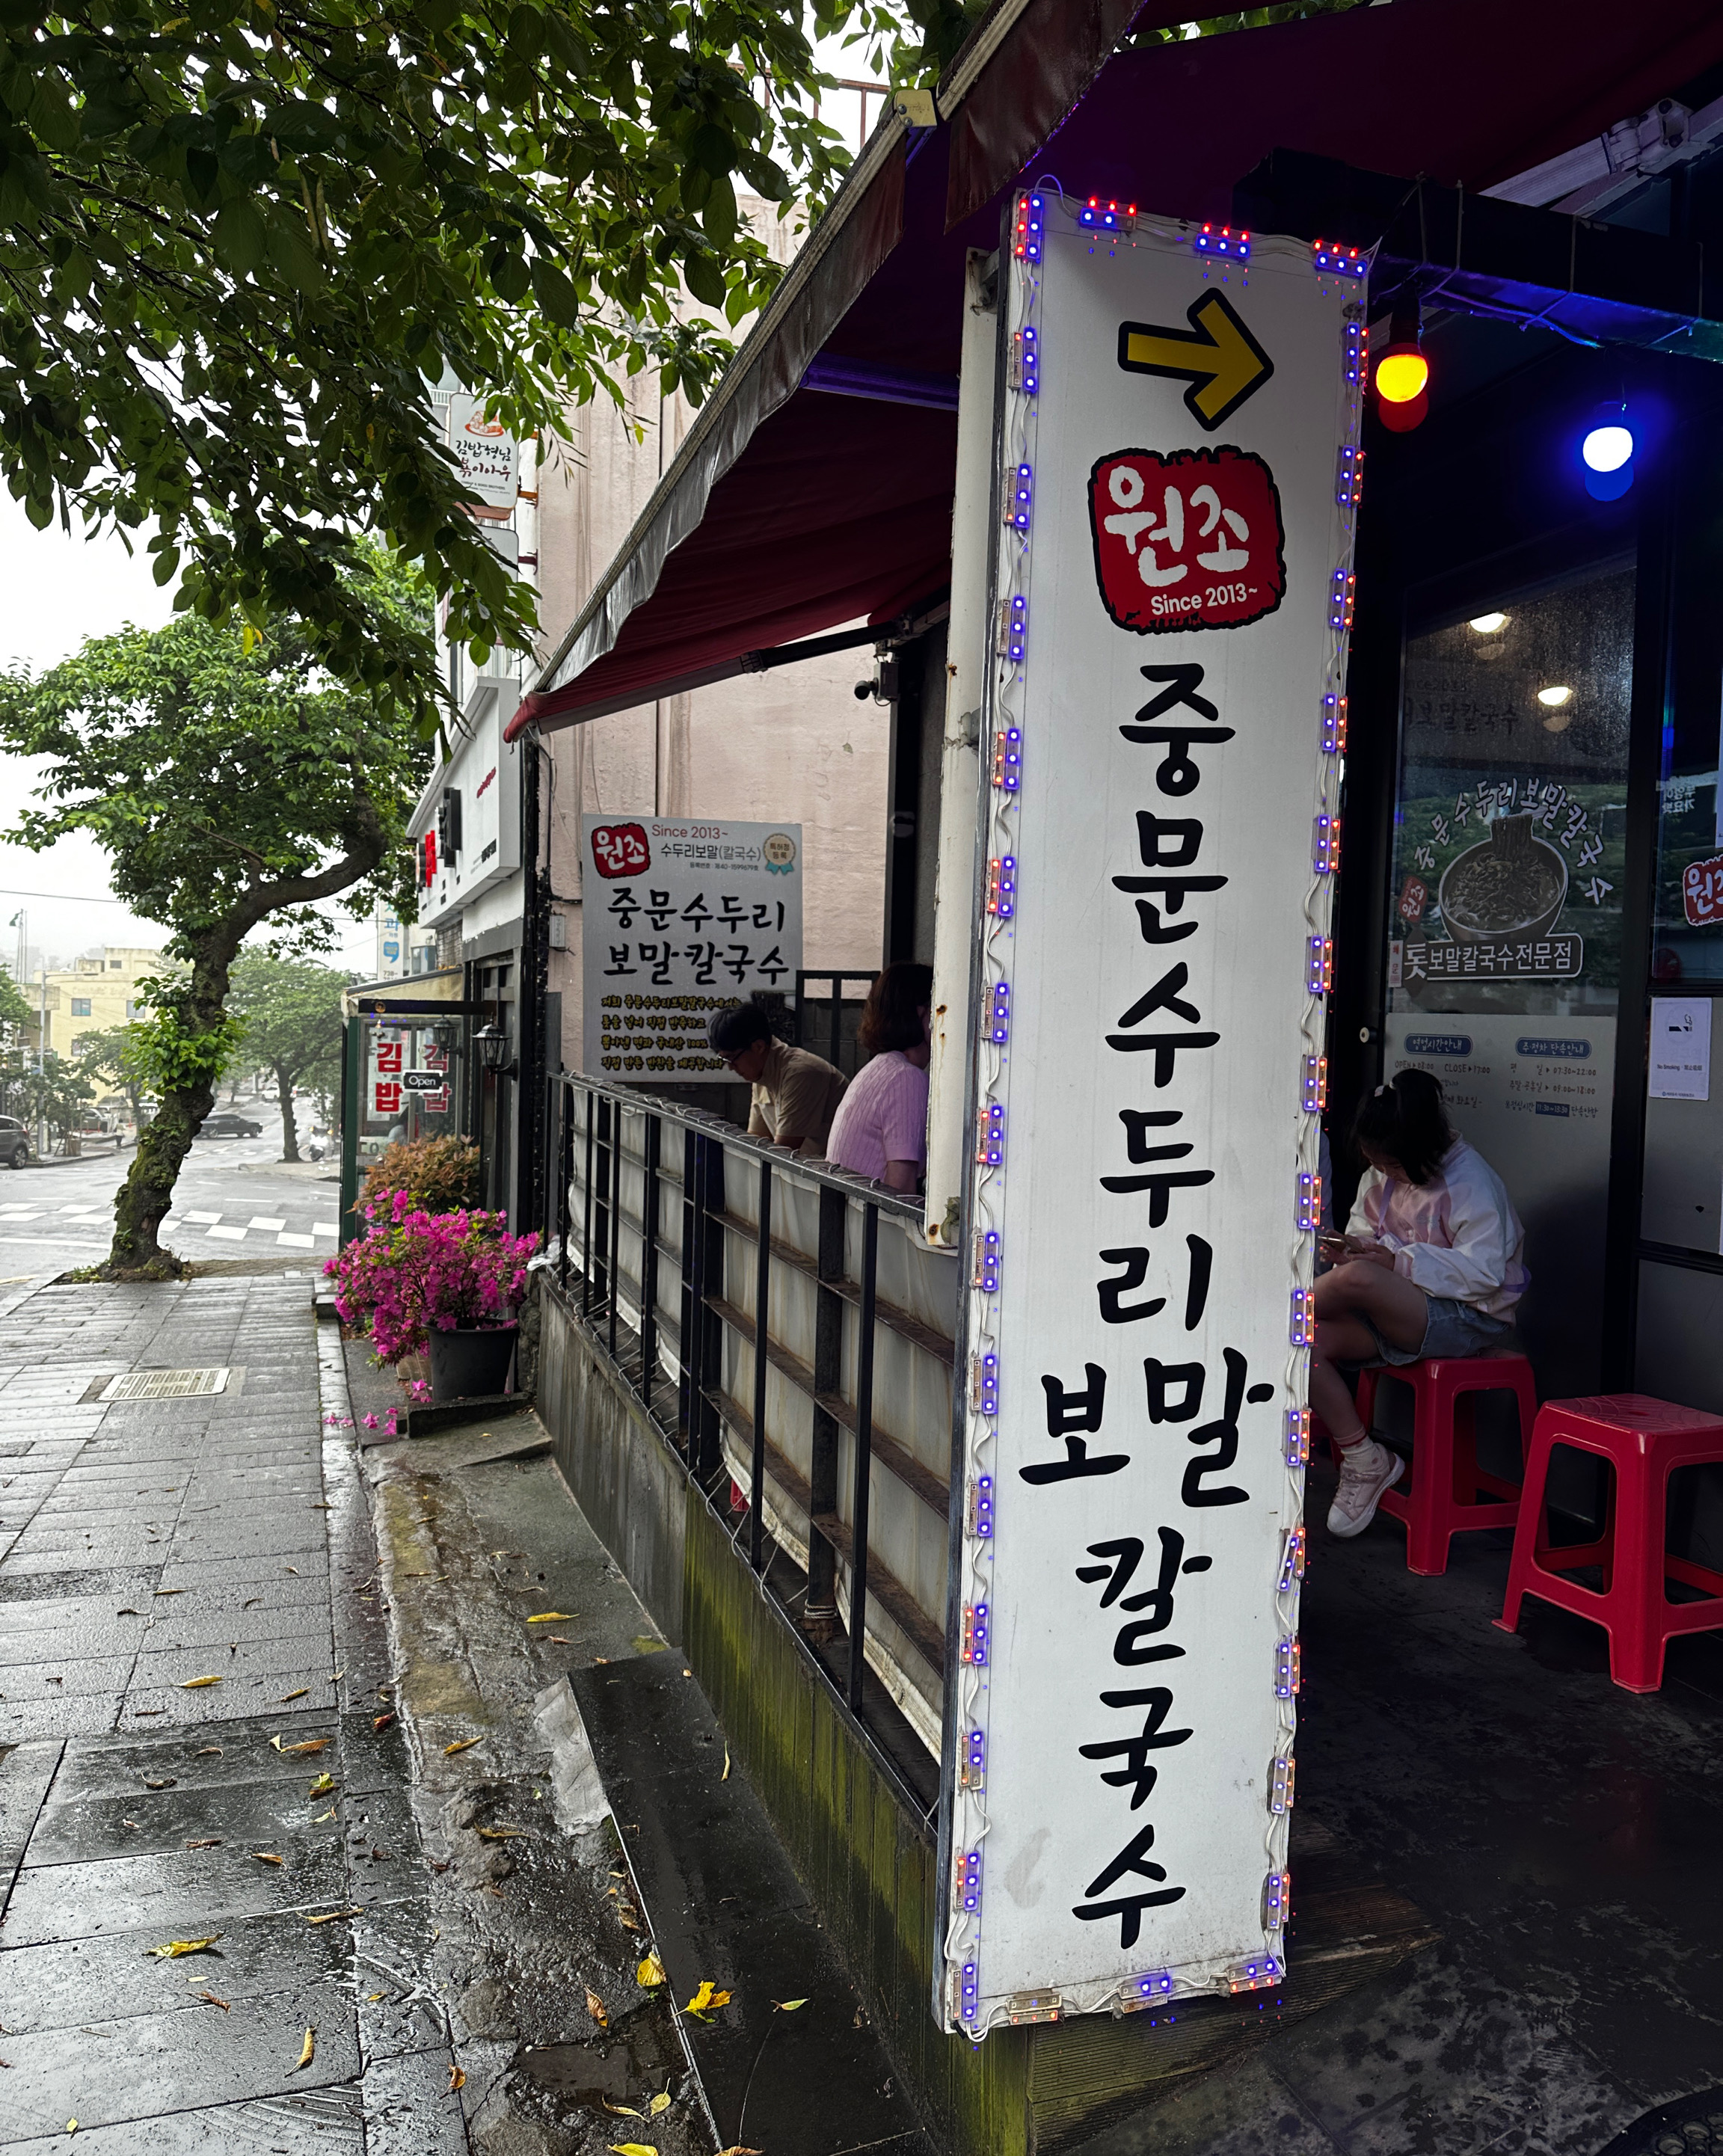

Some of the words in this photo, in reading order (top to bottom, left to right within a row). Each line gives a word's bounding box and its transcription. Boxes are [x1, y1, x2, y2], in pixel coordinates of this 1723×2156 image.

[455, 440, 512, 461] 김밥형님
[1104, 464, 1250, 588] 원조
[1152, 589, 1203, 616] Since
[1205, 583, 1259, 610] 2013~
[651, 824, 688, 838] Since
[691, 826, 728, 840] 2013~
[596, 830, 645, 870] 원조
[660, 843, 762, 862] 수두리보말(칼국수)
[608, 888, 784, 933] 중문수두리
[603, 942, 789, 985] 보말칼국수
[601, 995, 622, 1008] 저희
[1097, 663, 1235, 1330] 중문수두리
[624, 1015, 644, 1031] 넣어
[646, 1016, 666, 1031] 직접
[669, 1016, 707, 1031] 반죽하고
[656, 1036, 686, 1051] 국내산
[687, 1038, 708, 1049] 100%
[1413, 1037, 1462, 1052] 영업시간안내
[375, 1042, 404, 1113] 김밥
[601, 1056, 621, 1071] 직접
[624, 1056, 644, 1071] 만든
[677, 1057, 725, 1072] 제공합니다
[408, 1075, 436, 1088] Open
[1019, 1348, 1274, 1507] 보말
[1072, 1526, 1212, 1949] 칼국수
